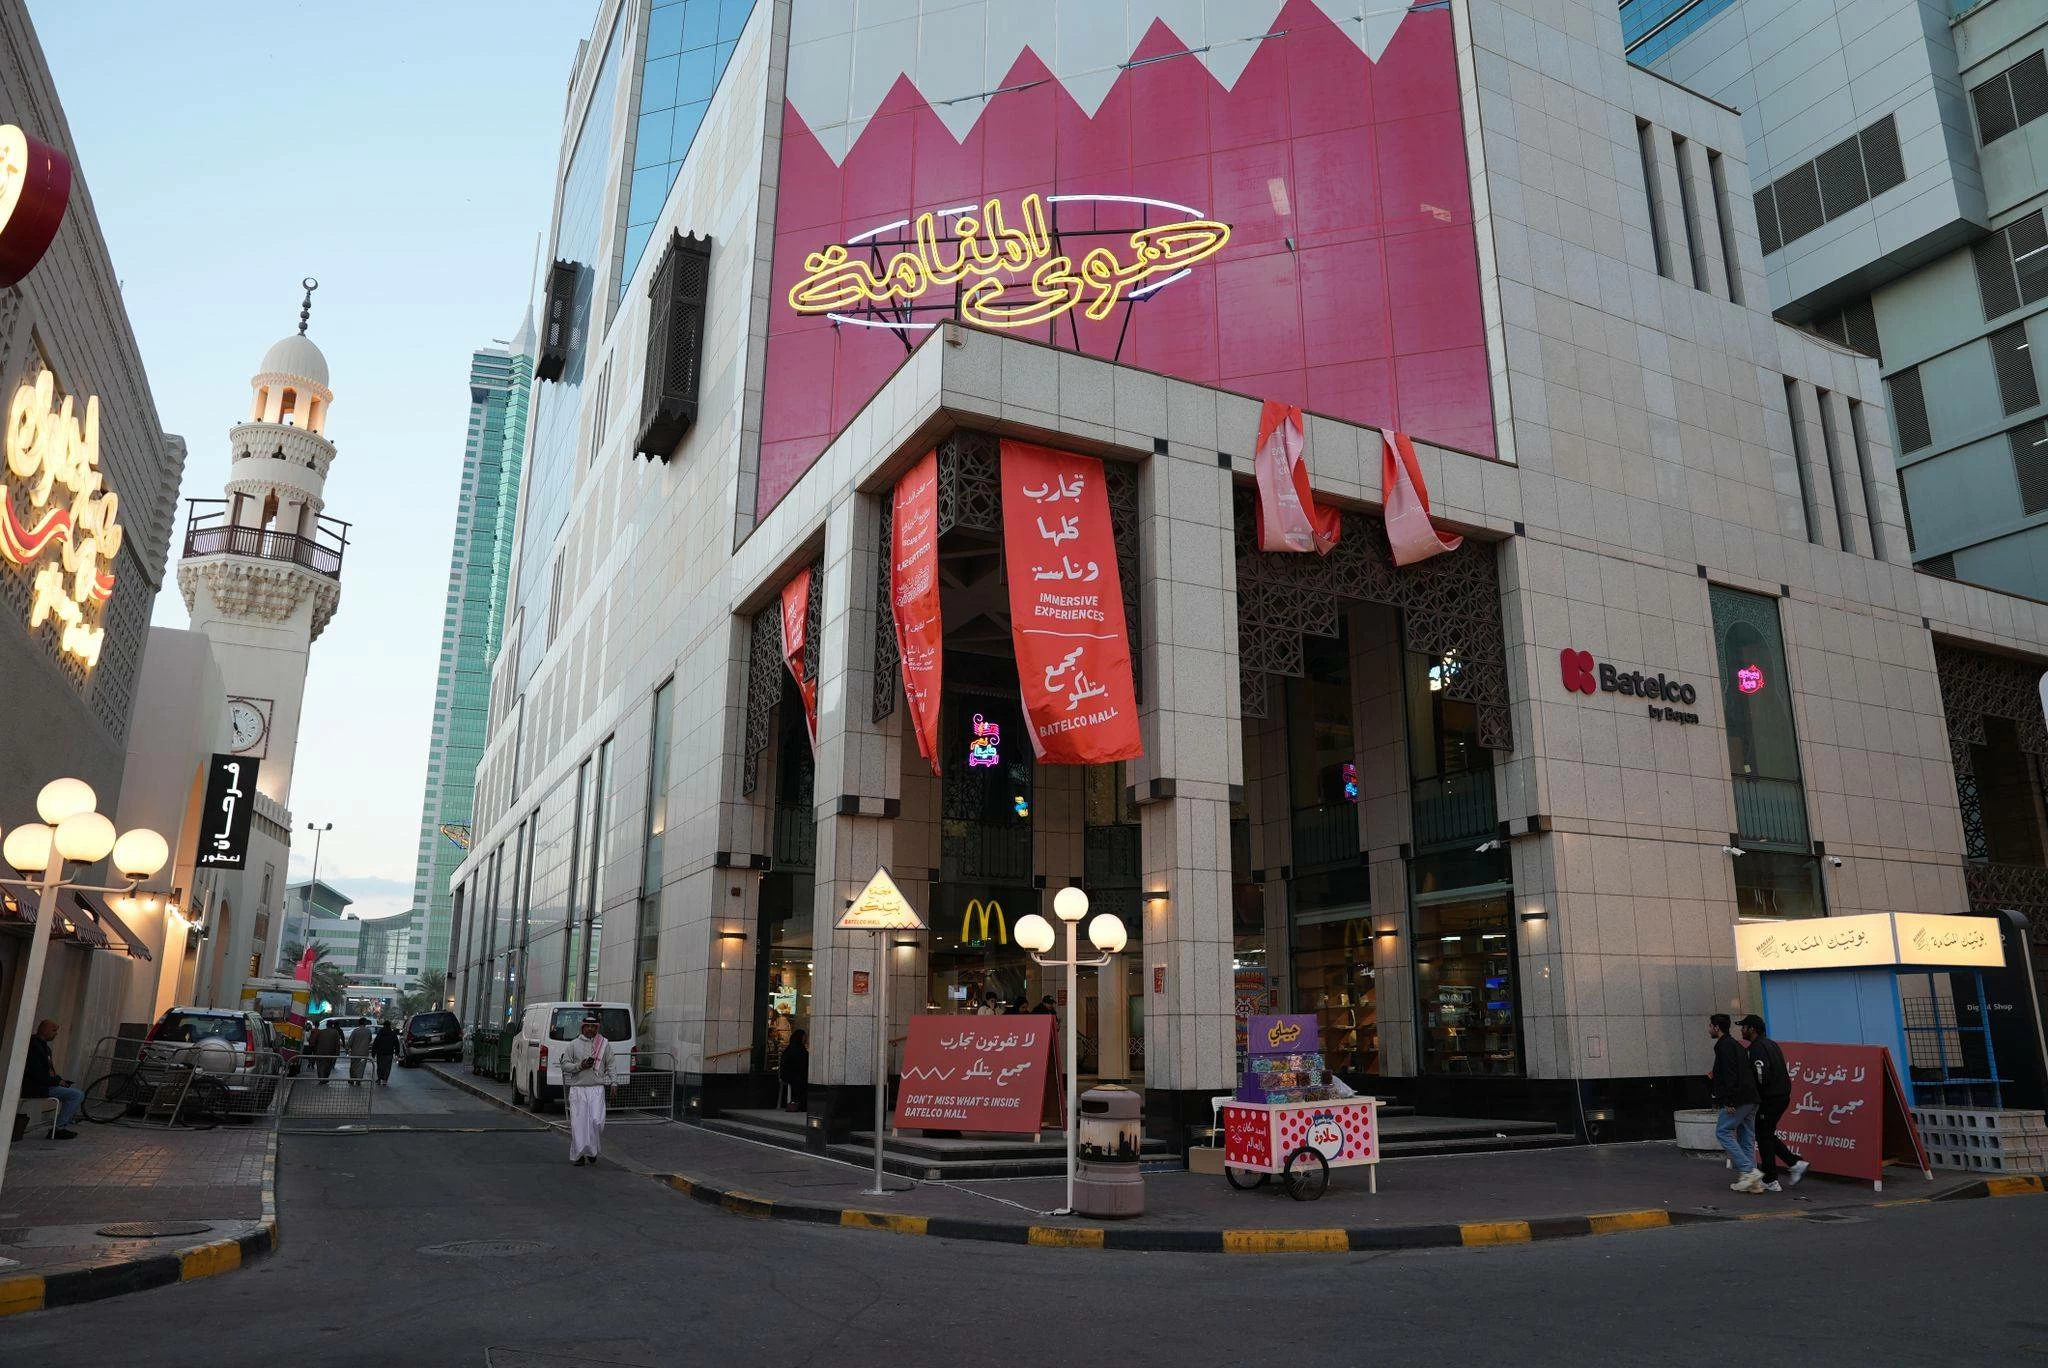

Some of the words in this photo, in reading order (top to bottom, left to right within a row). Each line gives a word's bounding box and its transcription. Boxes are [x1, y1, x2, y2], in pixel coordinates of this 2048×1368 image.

[789, 193, 1050, 311] المنامة
[1022, 473, 1085, 504] تجارب
[1036, 515, 1079, 547] كلها
[1031, 555, 1099, 582] وناسة
[1040, 592, 1099, 606] IMMERSIVE
[1034, 605, 1105, 622] EXPERIENCES
[1044, 646, 1084, 692] مجمع
[1065, 670, 1109, 711] بتلكو
[1599, 662, 1697, 705] Batelco
[1040, 716, 1087, 737] BATELCO
[1088, 706, 1119, 725] MALL
[1648, 705, 1663, 724] by
[1993, 1003, 2013, 1011] Shop
[940, 1032, 975, 1050] تجارب
[975, 1032, 1019, 1052] تفوتون
[1021, 1032, 1035, 1047] لا
[961, 1057, 994, 1081] بتلكو
[996, 1061, 1031, 1086] مجمع
[1786, 1061, 1801, 1081] تجا
[1803, 1065, 1847, 1086] تفوتون
[1850, 1066, 1865, 1082] لا
[907, 1095, 933, 1104] DON'T
[934, 1096, 955, 1106] MISS
[956, 1096, 990, 1107] WHAT'S
[990, 1097, 1020, 1107] INSIDE
[1791, 1091, 1824, 1116] بتلكو
[904, 1108, 943, 1118] BATELCO
[943, 1109, 968, 1119] MALL
[1828, 1098, 1864, 1125] مجمع
[1315, 1128, 1339, 1145] حلاوة
[1788, 1131, 1823, 1145] WHAT'S
[1824, 1135, 1856, 1149] INSIDE
